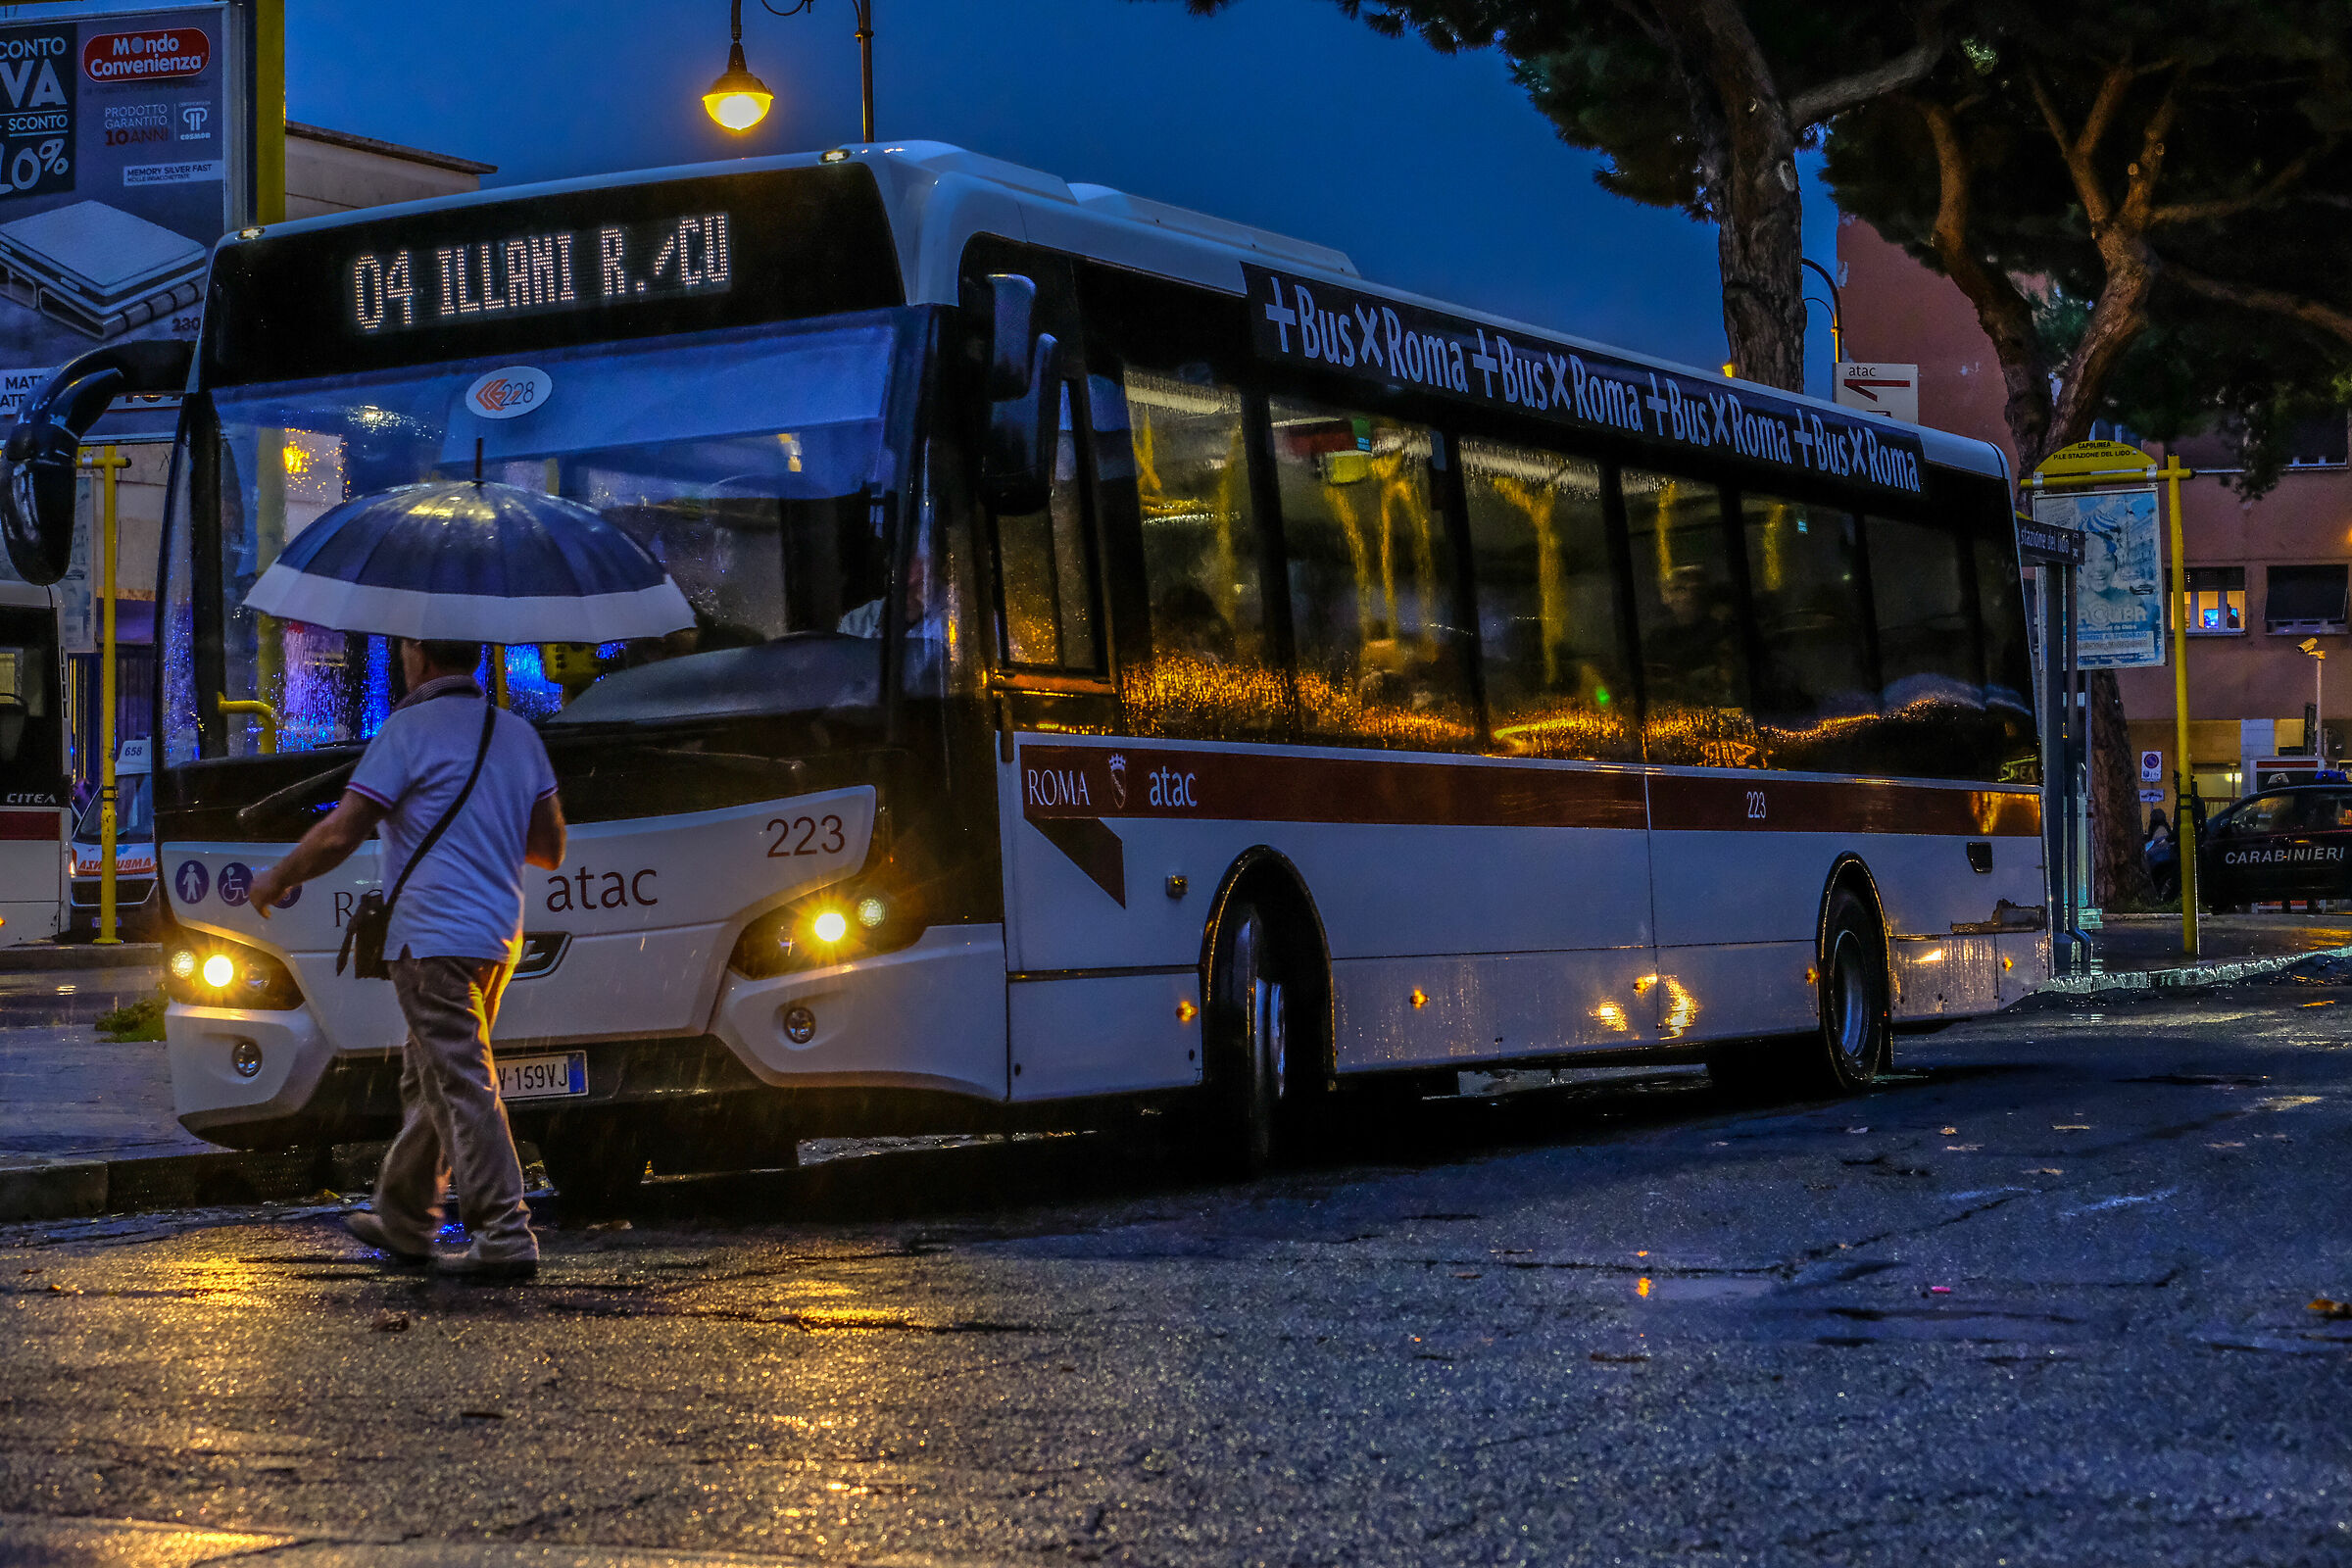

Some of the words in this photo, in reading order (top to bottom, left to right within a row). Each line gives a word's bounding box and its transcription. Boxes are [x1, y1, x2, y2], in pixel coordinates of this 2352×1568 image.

[90, 54, 202, 77] Convenienza
[105, 103, 168, 118] PRODOTTO
[8, 114, 69, 131] SCONTO
[105, 115, 168, 129] GARANTITO
[105, 129, 128, 146] 10
[130, 127, 169, 144] ANNI
[127, 167, 162, 177] MEMORY
[164, 165, 191, 174] SILVER
[354, 250, 413, 330] 04
[437, 234, 575, 316] ILLANI
[1848, 366, 1877, 377] atac
[500, 381, 535, 407] 228
[124, 747, 142, 757] 658
[1028, 768, 1091, 806] ROMA
[1149, 765, 1198, 808] atac
[7, 793, 56, 804] CITEA
[1746, 791, 1766, 818] 223
[765, 814, 846, 858] 223
[2225, 847, 2345, 864] CARABINIERI
[546, 866, 659, 913] atac
